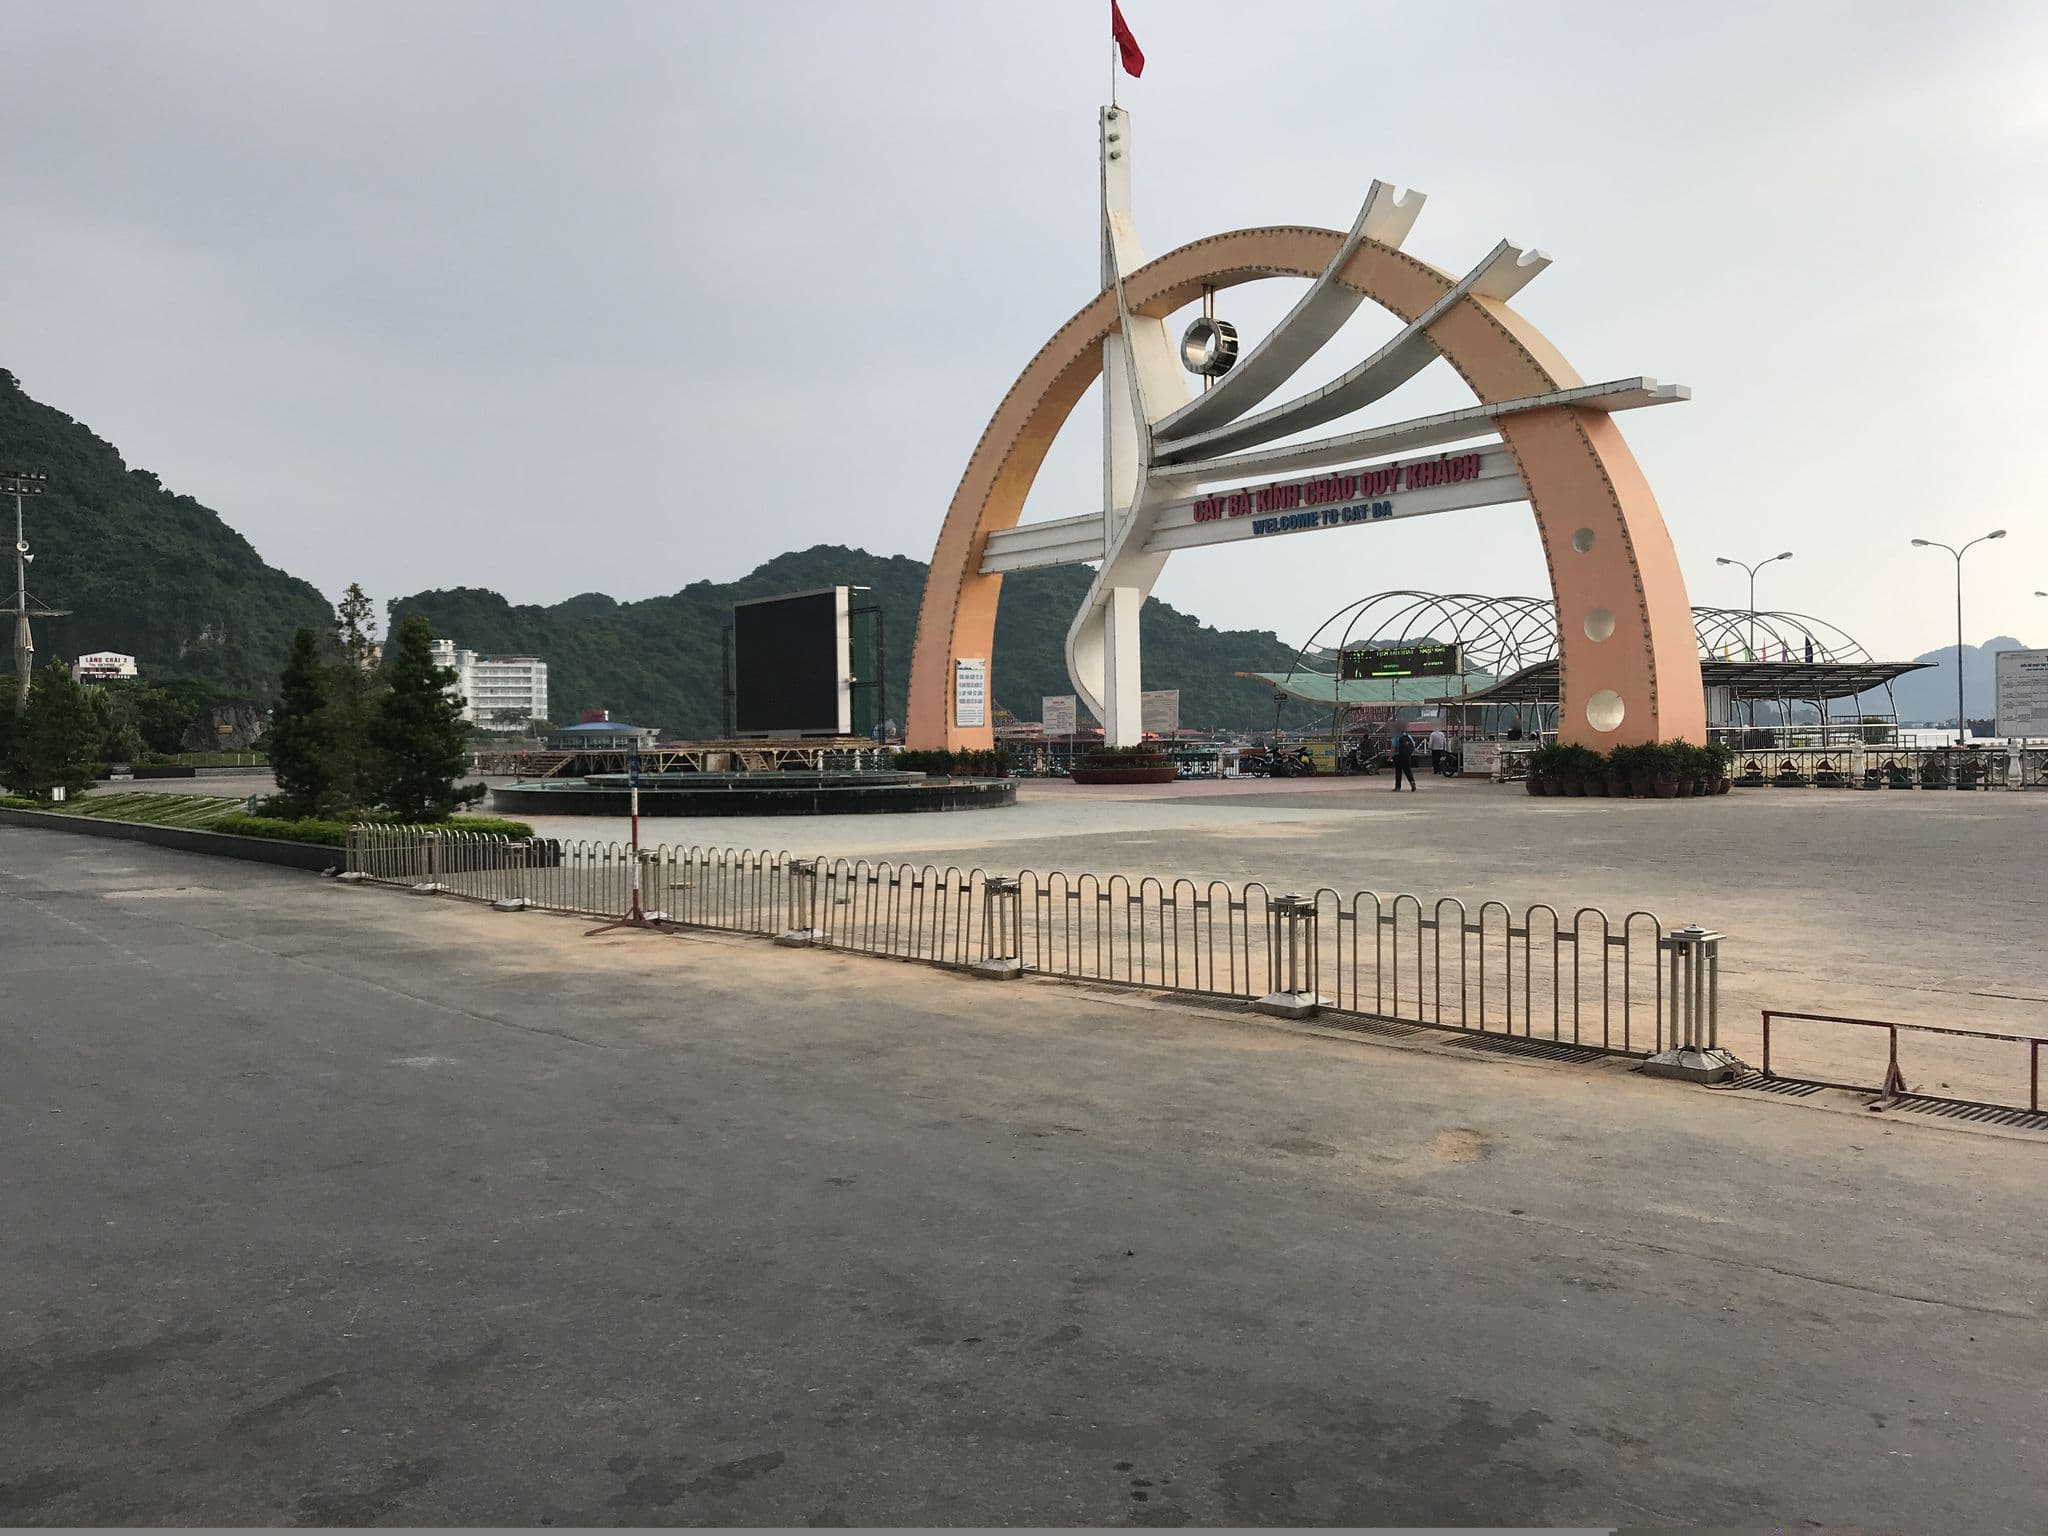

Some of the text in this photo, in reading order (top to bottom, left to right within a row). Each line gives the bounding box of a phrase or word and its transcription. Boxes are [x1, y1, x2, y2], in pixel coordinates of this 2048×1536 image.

[1228, 488, 1252, 517] BÀ
[1405, 452, 1480, 489] KHÁCH
[1252, 500, 1392, 535] WELCOME TO CAT BA
